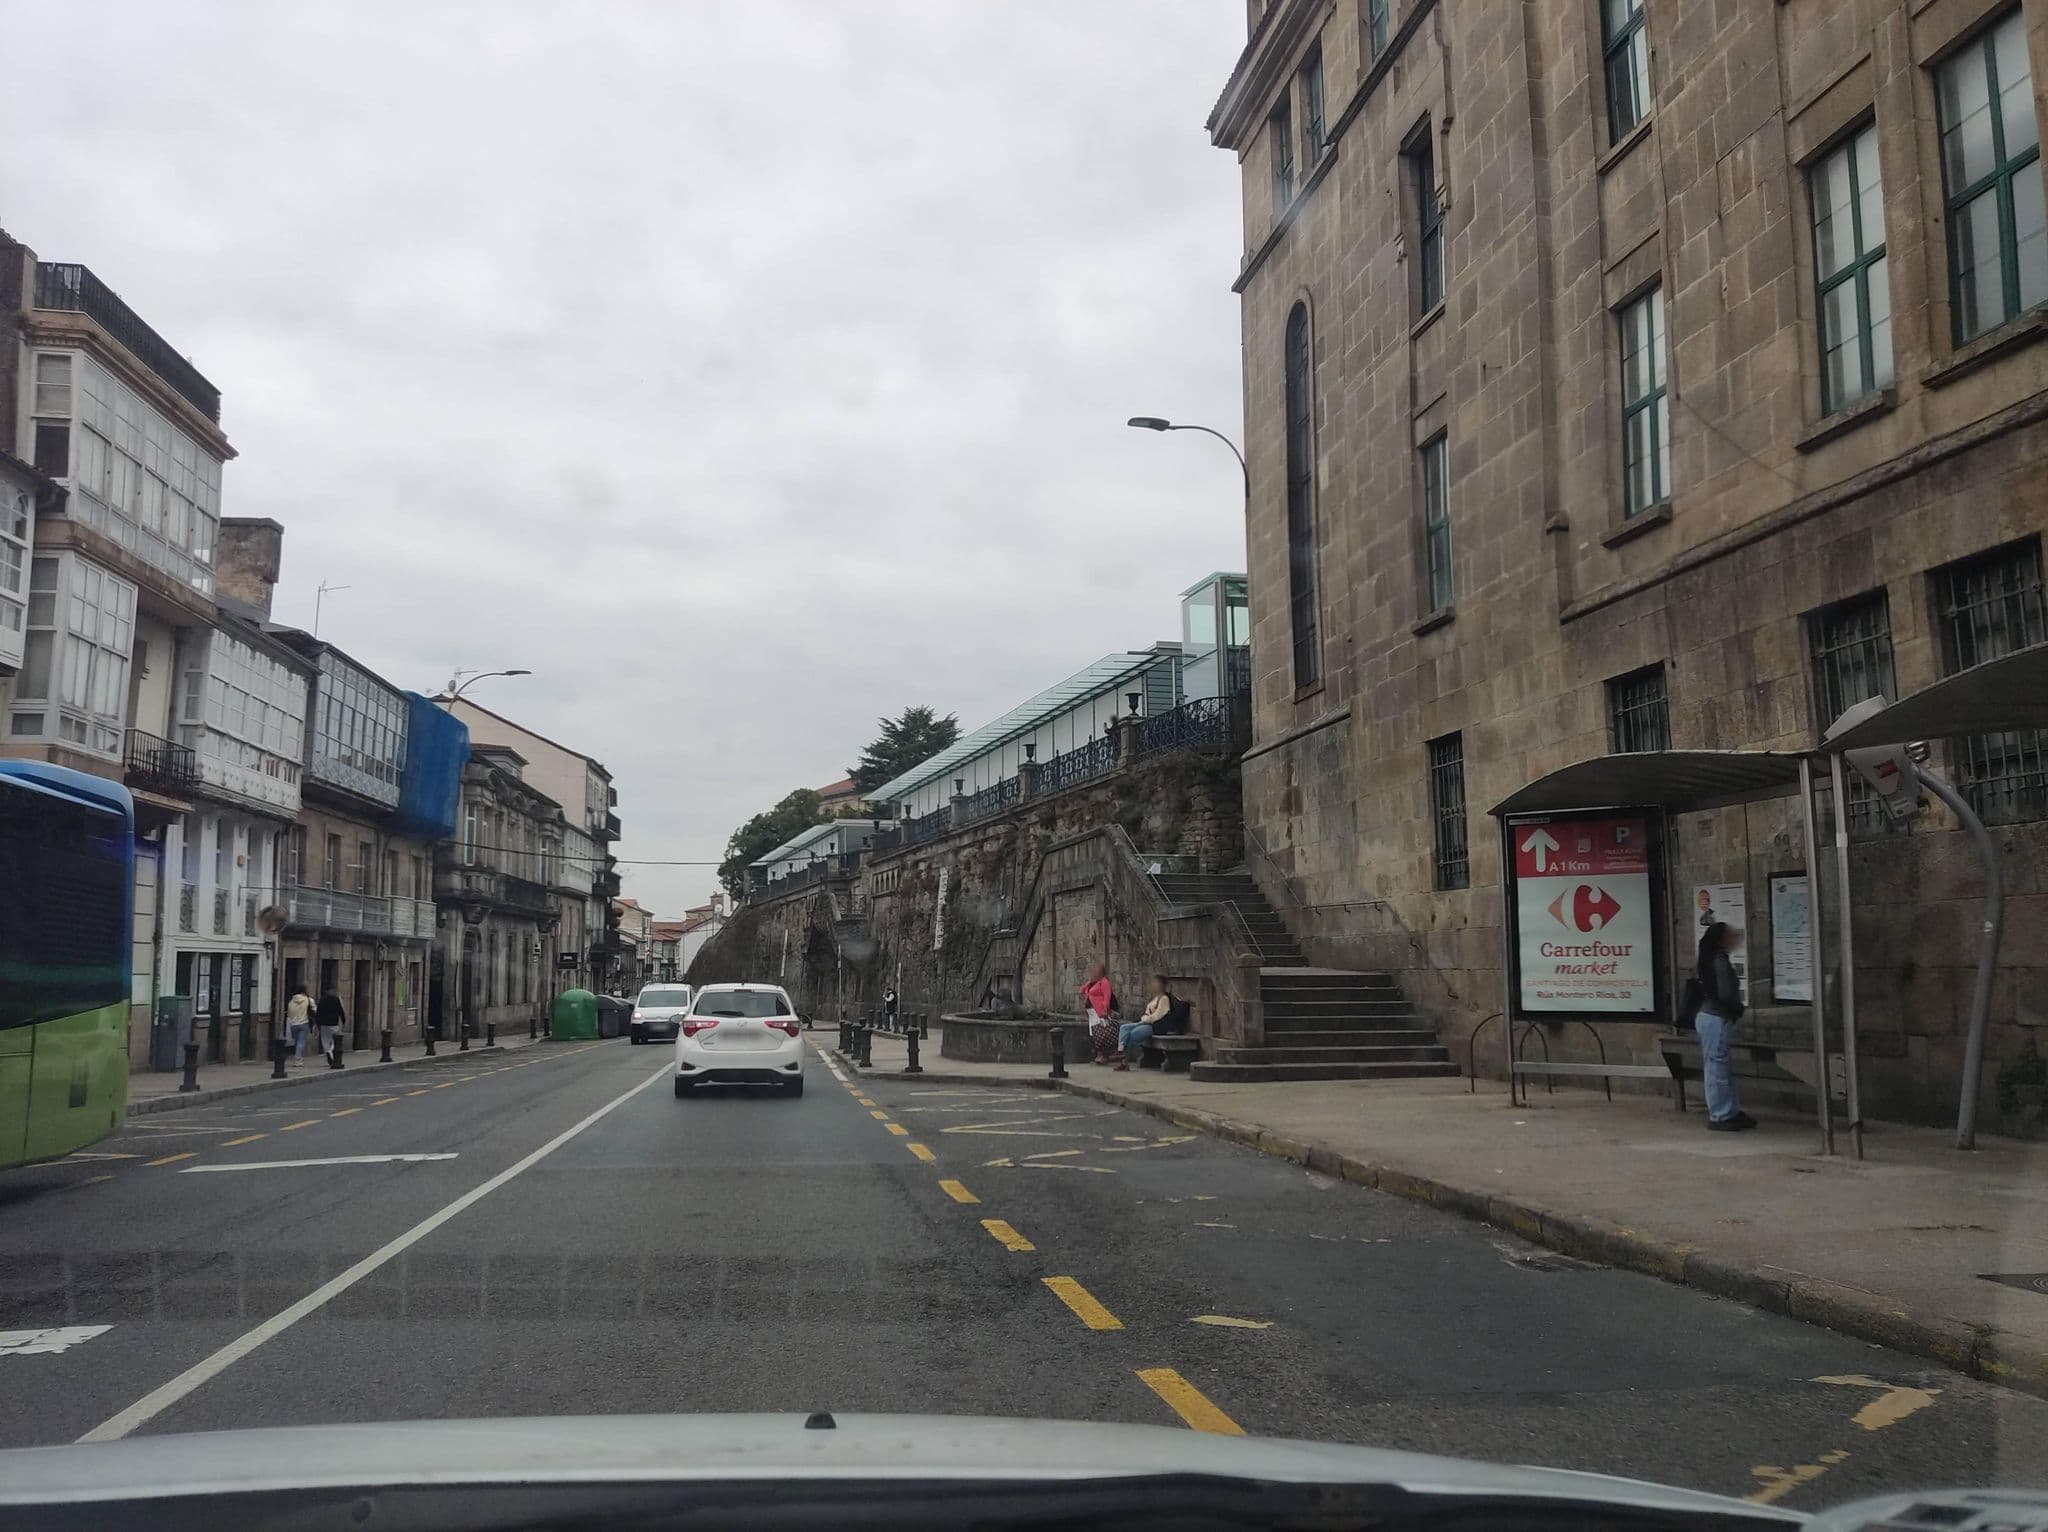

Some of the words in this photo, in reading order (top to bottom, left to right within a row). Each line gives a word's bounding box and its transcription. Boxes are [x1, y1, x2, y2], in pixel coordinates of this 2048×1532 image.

[1616, 826, 1631, 843] P
[1549, 863, 1559, 872] A
[1568, 860, 1590, 871] Km
[1540, 941, 1633, 958] Carrefour
[1554, 960, 1619, 976] market
